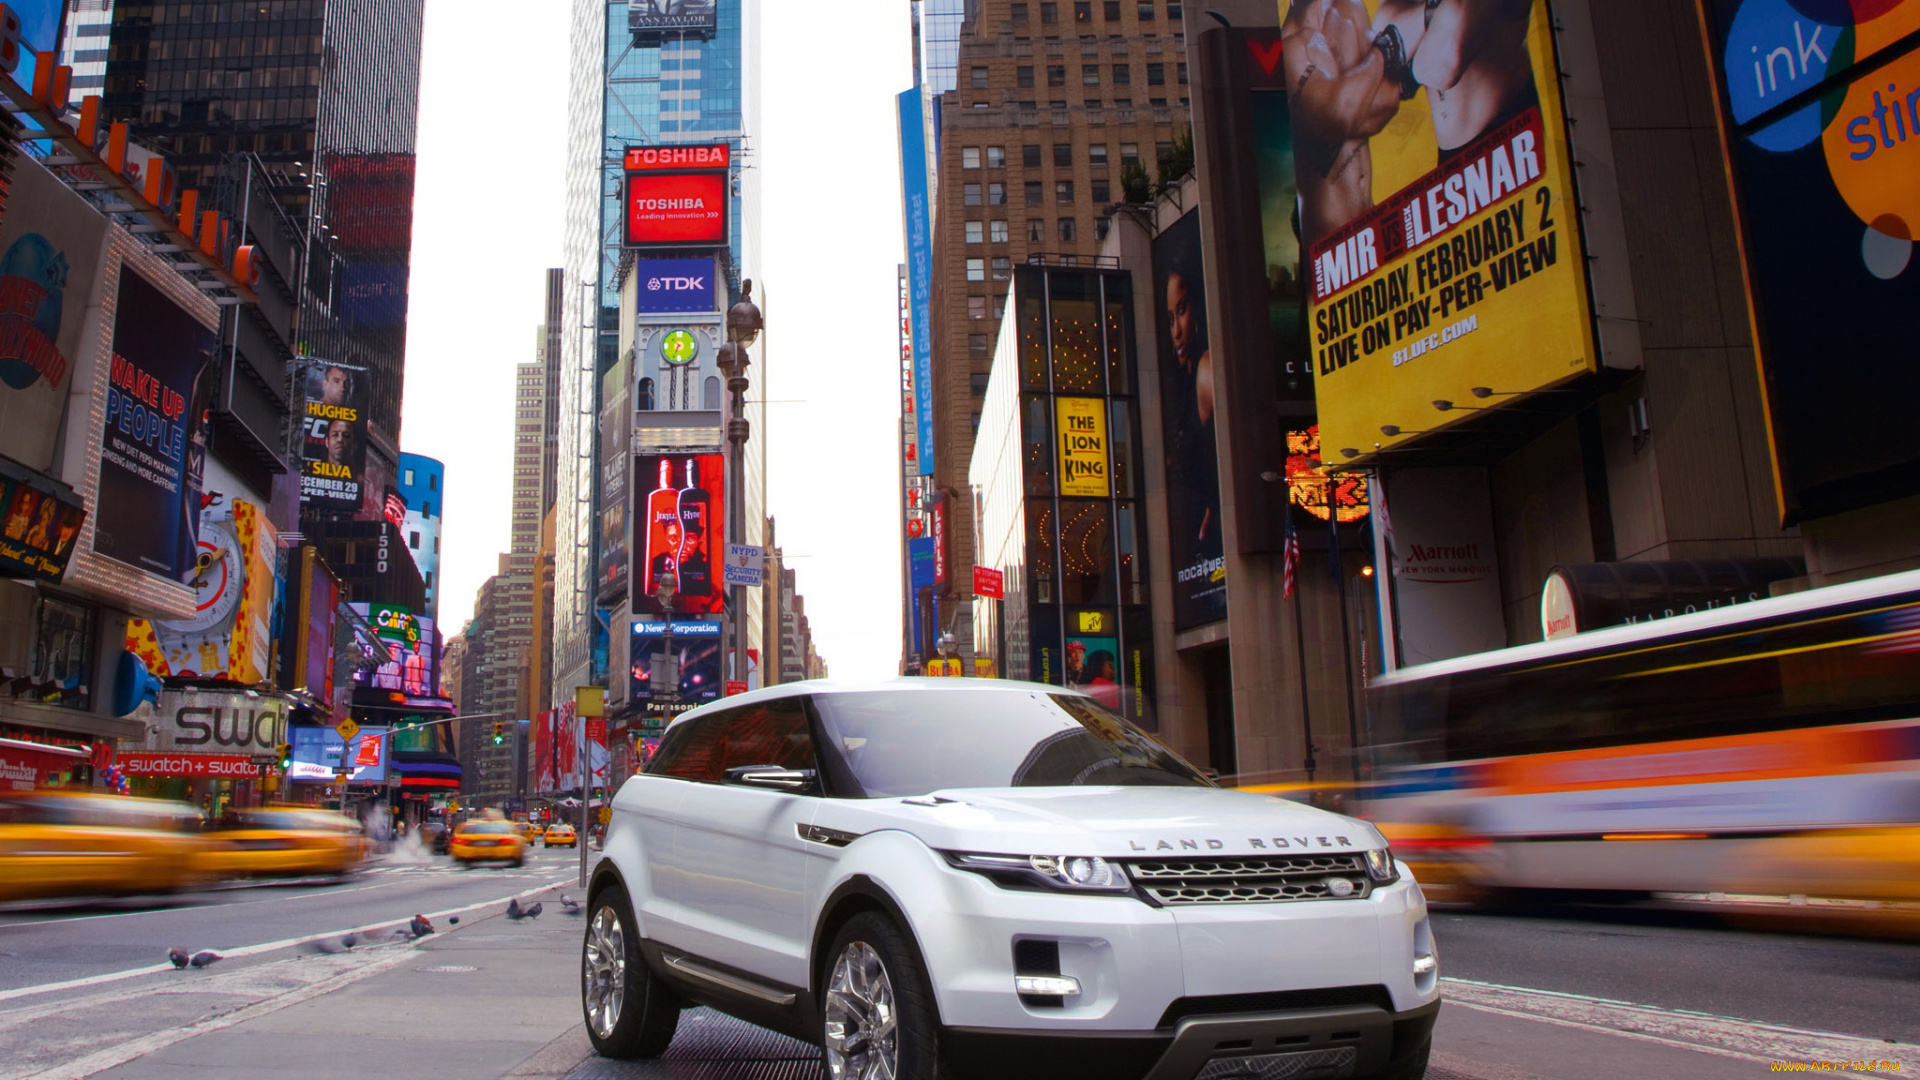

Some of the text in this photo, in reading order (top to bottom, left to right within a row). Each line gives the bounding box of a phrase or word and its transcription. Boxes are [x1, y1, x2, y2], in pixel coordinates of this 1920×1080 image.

[637, 15, 706, 24] ANN TAYLOR
[1751, 20, 1828, 98] ink
[629, 148, 723, 164] TOSHIBA
[1403, 130, 1540, 249] BROCK LESNAR
[637, 198, 704, 210] TOSHIBA
[637, 211, 705, 220] Leading Innovation
[913, 193, 925, 250] Market
[1315, 227, 1379, 298] FRANK MIR
[1316, 186, 1554, 345] SATURDAY, FEBRUARY 2
[660, 277, 705, 290] TDK
[915, 253, 928, 299] Select
[1319, 230, 1557, 376] LIVE ON PAY-PER-VIEW
[1393, 314, 1478, 368] 81.UFC.COM
[111, 352, 185, 421] WAKE UP
[308, 402, 357, 421] HUGHES
[105, 386, 184, 462] PEOPLE
[304, 417, 329, 438] FC
[1067, 416, 1095, 429] THE
[1064, 433, 1101, 456] LION
[112, 437, 178, 480] NEW DIET PEPSI MAX WITH
[604, 451, 627, 483] PLANET
[125, 459, 138, 473] AND
[138, 465, 153, 481] MORE
[312, 461, 352, 478] SILVA
[1065, 459, 1103, 482] KING
[301, 476, 358, 492] ECEMBER 29
[377, 523, 388, 573] 1500
[731, 546, 758, 557] NYPD
[1407, 544, 1479, 562] Marriott
[724, 564, 762, 576] SECURITY
[725, 573, 759, 584] CAMERA
[982, 569, 1002, 579] STOPPING
[1421, 566, 1446, 574] YORK
[1449, 566, 1492, 574] MARQUIS
[978, 578, 998, 587] ANYTIME
[645, 624, 718, 634] New Corporation
[1079, 612, 1103, 632] MTV
[1547, 614, 1571, 637] Marriott
[129, 758, 192, 773] swatch
[1129, 836, 1352, 850] LAND ROVER
